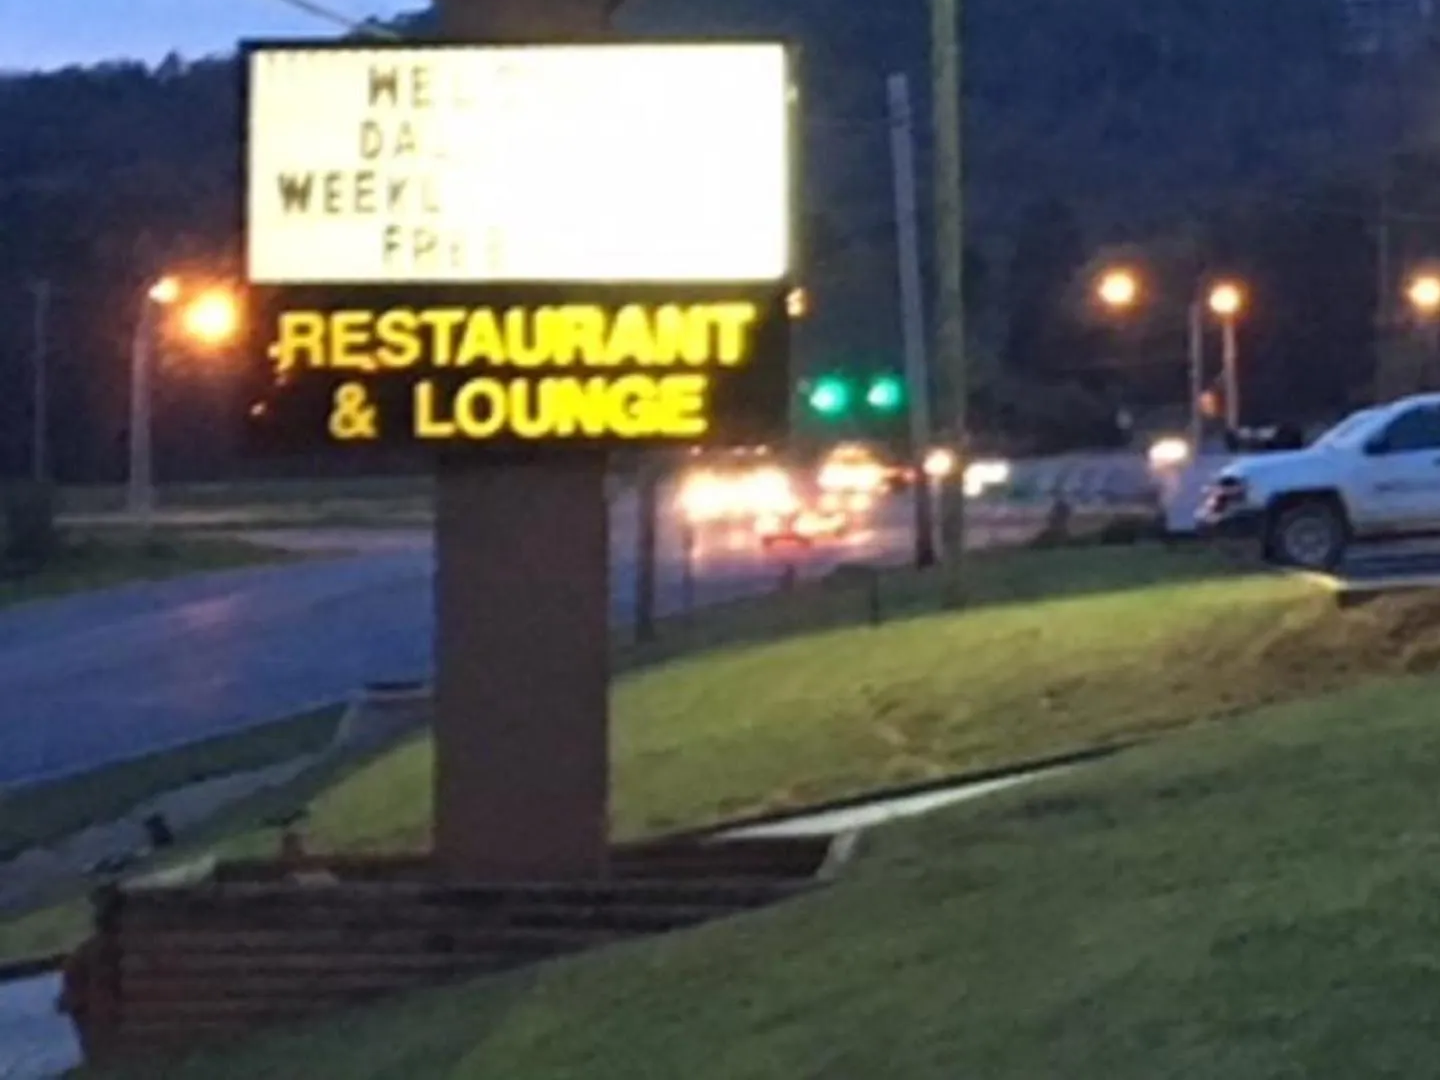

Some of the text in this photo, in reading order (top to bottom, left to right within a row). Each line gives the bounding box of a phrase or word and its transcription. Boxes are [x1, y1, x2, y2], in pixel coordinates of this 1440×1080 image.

[277, 302, 756, 369] RESTAURANT
[328, 375, 709, 439] & LOUNGE
